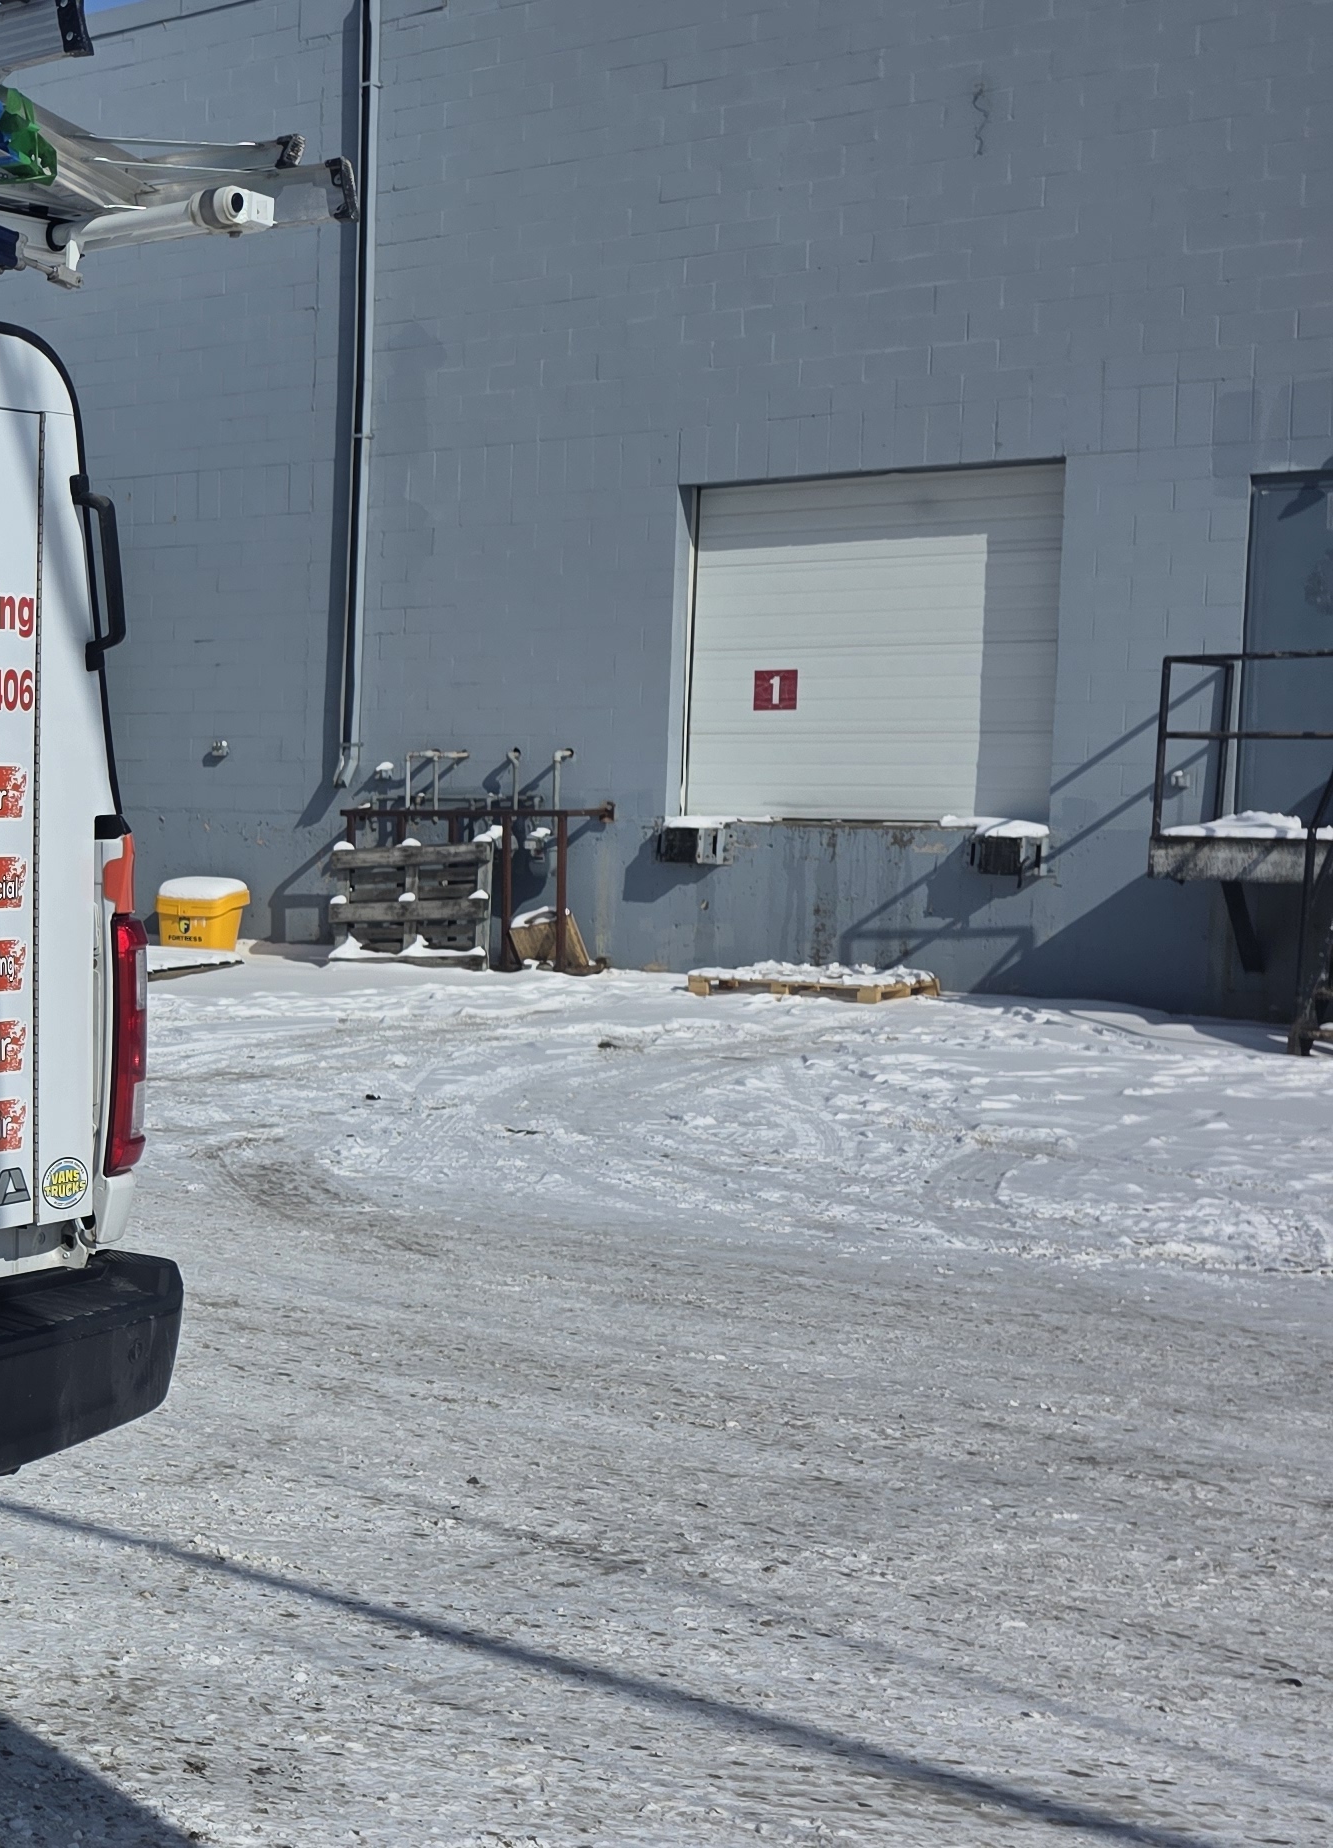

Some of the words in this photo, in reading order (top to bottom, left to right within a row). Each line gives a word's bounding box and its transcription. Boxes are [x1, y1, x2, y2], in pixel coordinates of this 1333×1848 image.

[769, 675, 781, 705] 1
[167, 934, 203, 943] FORTRESS
[51, 1169, 80, 1185] VANS
[43, 1180, 87, 1198] TRUCKS
